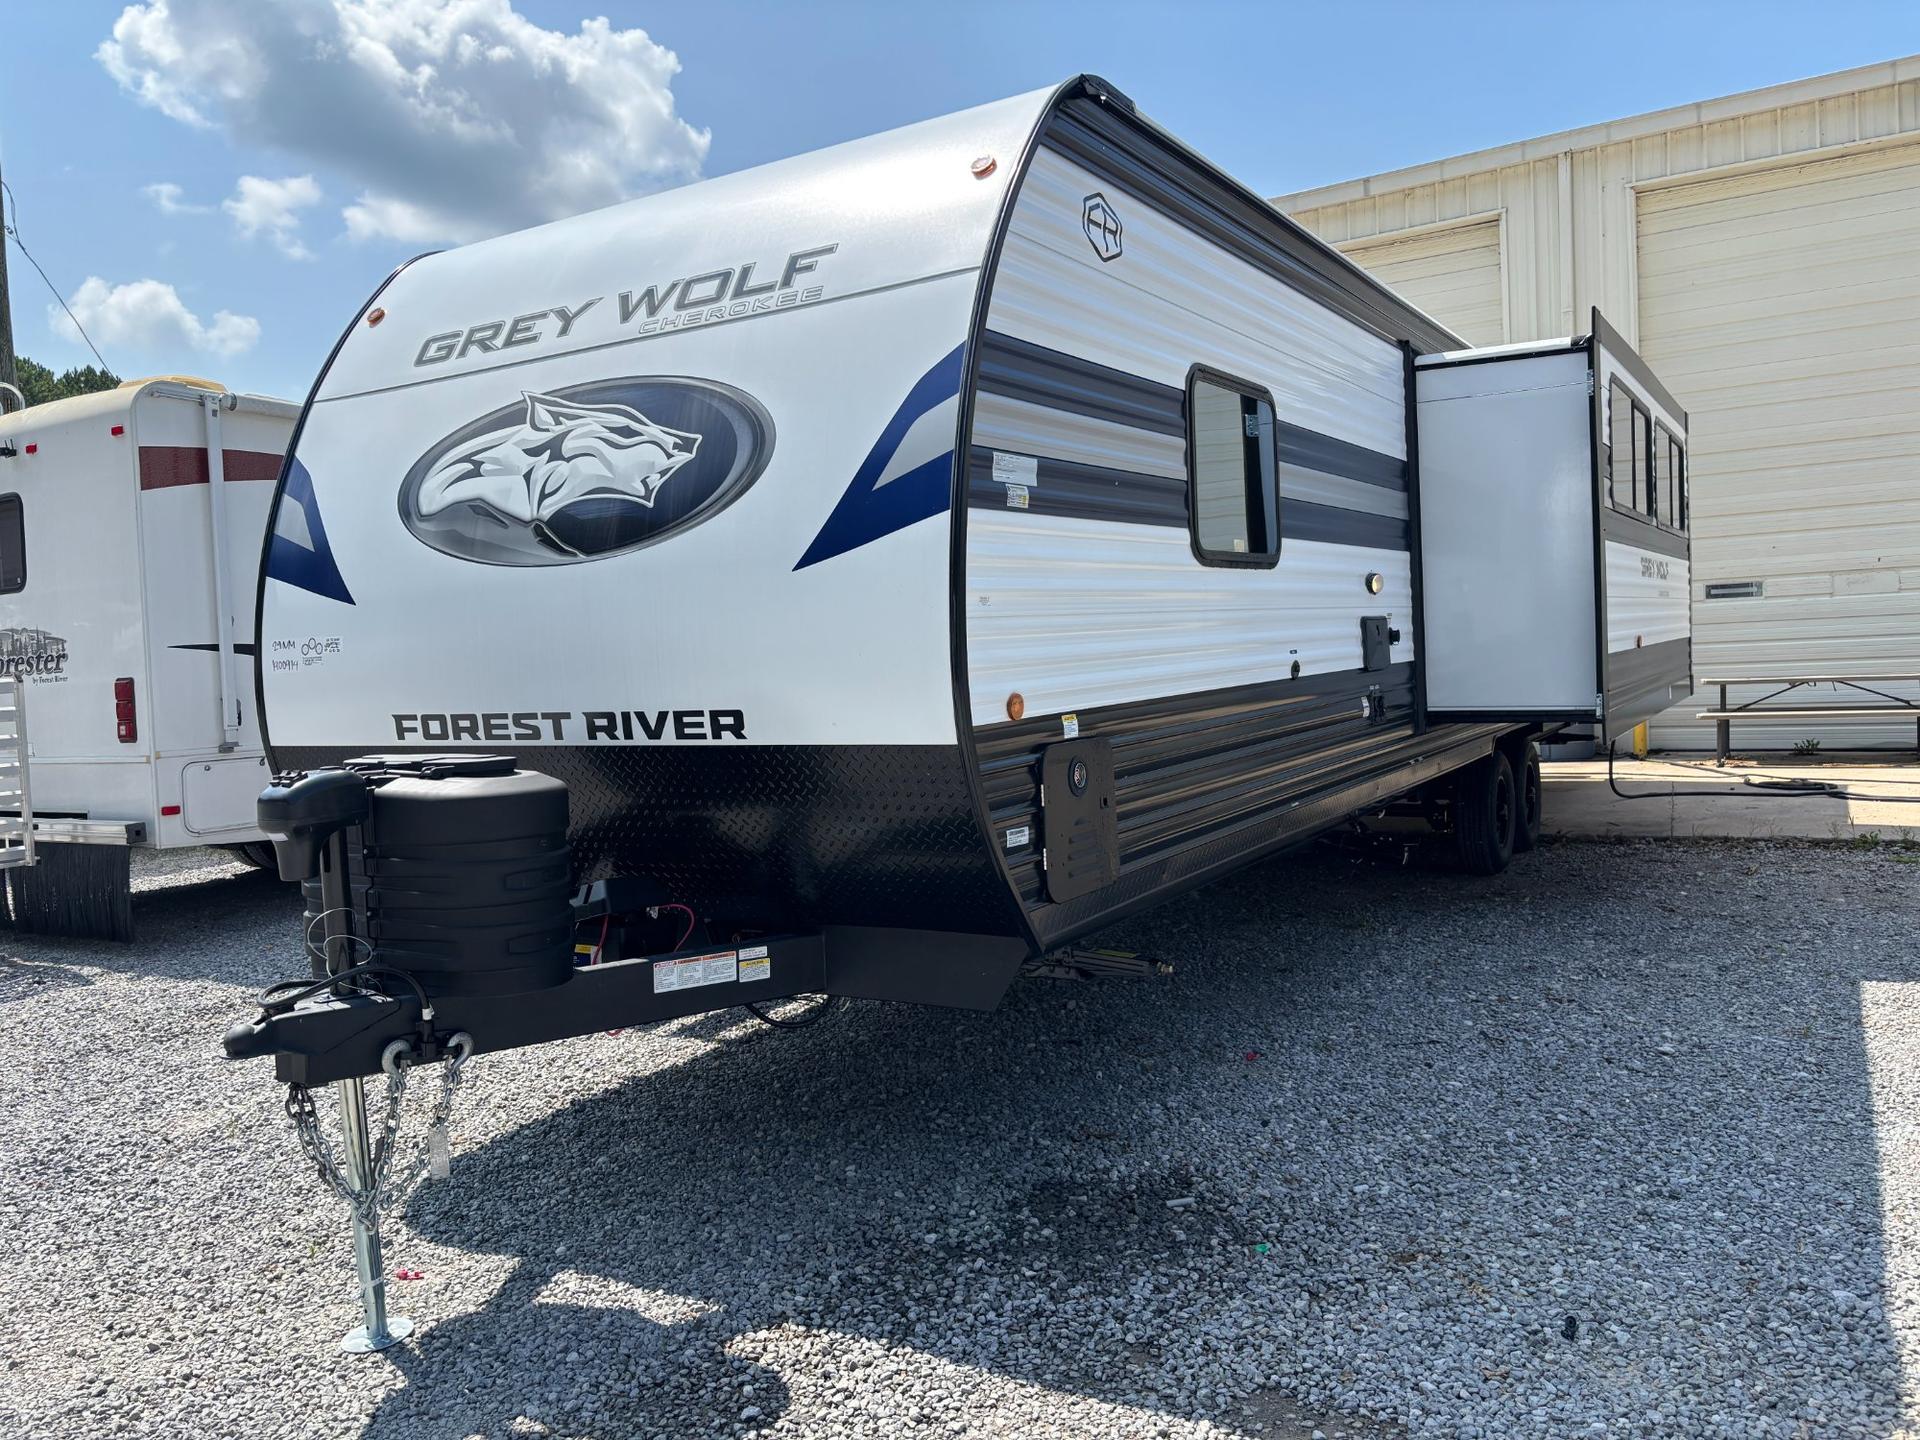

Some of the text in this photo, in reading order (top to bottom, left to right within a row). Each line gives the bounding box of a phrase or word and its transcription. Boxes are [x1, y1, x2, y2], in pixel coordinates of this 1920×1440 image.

[413, 243, 839, 367] GREY WOLF
[638, 285, 825, 335] CHEROKEE
[391, 709, 748, 741] FOREST RIVER
